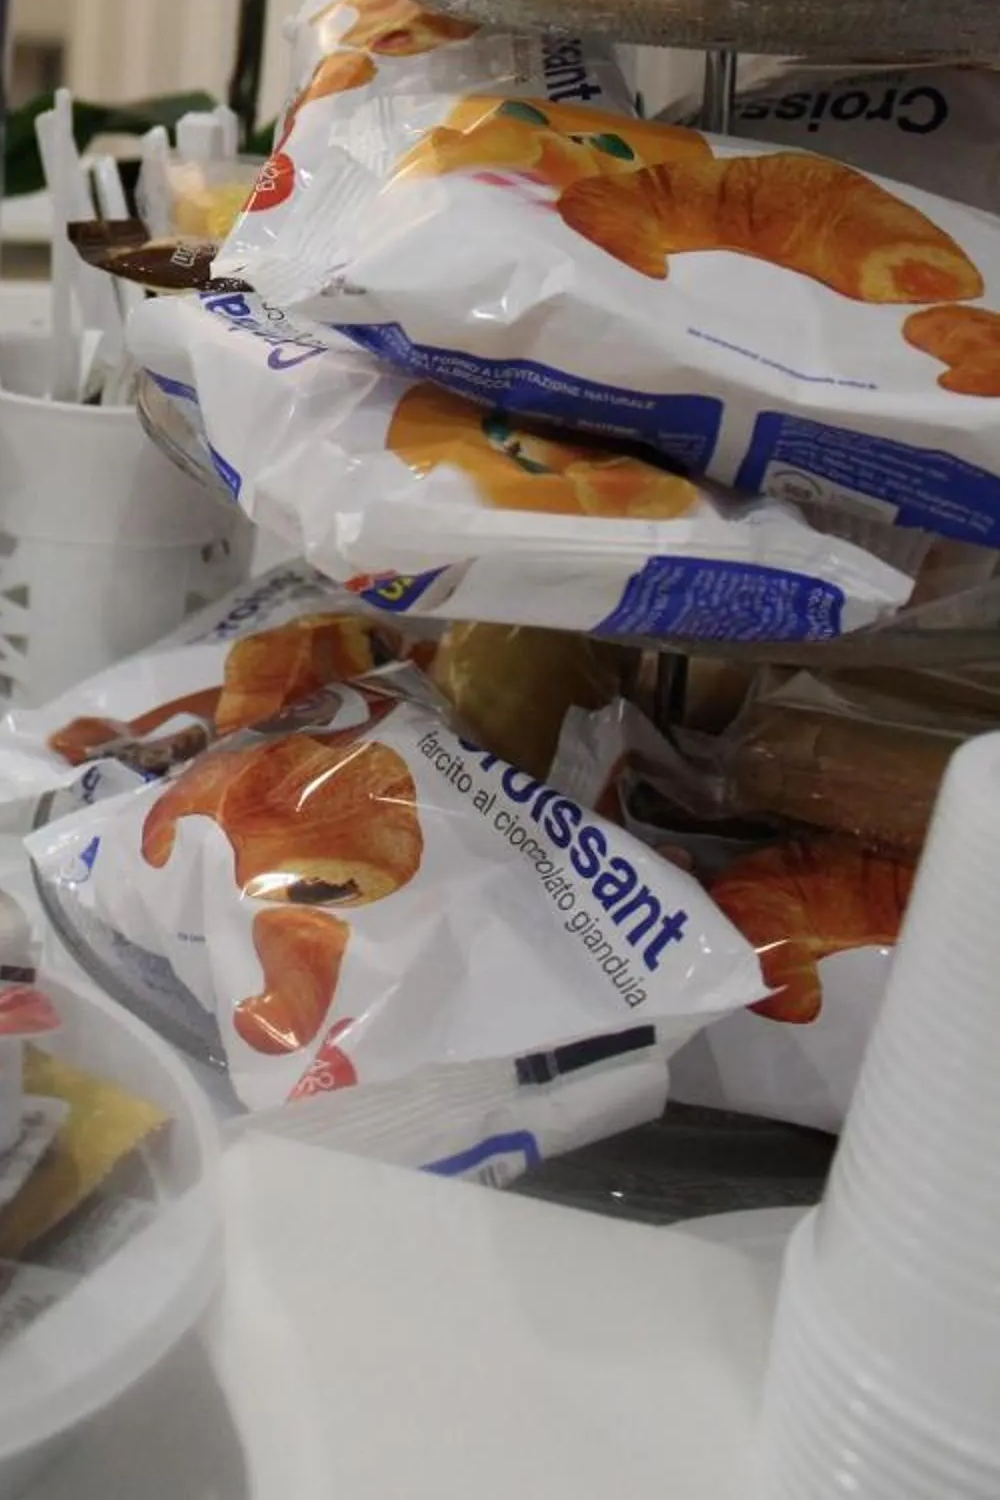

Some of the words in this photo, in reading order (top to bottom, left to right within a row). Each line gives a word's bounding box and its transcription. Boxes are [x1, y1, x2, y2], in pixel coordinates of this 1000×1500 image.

[417, 729, 473, 794] farcito
[472, 789, 497, 817] al
[564, 909, 648, 1010] gianduia
[459, 734, 689, 973] oissant
